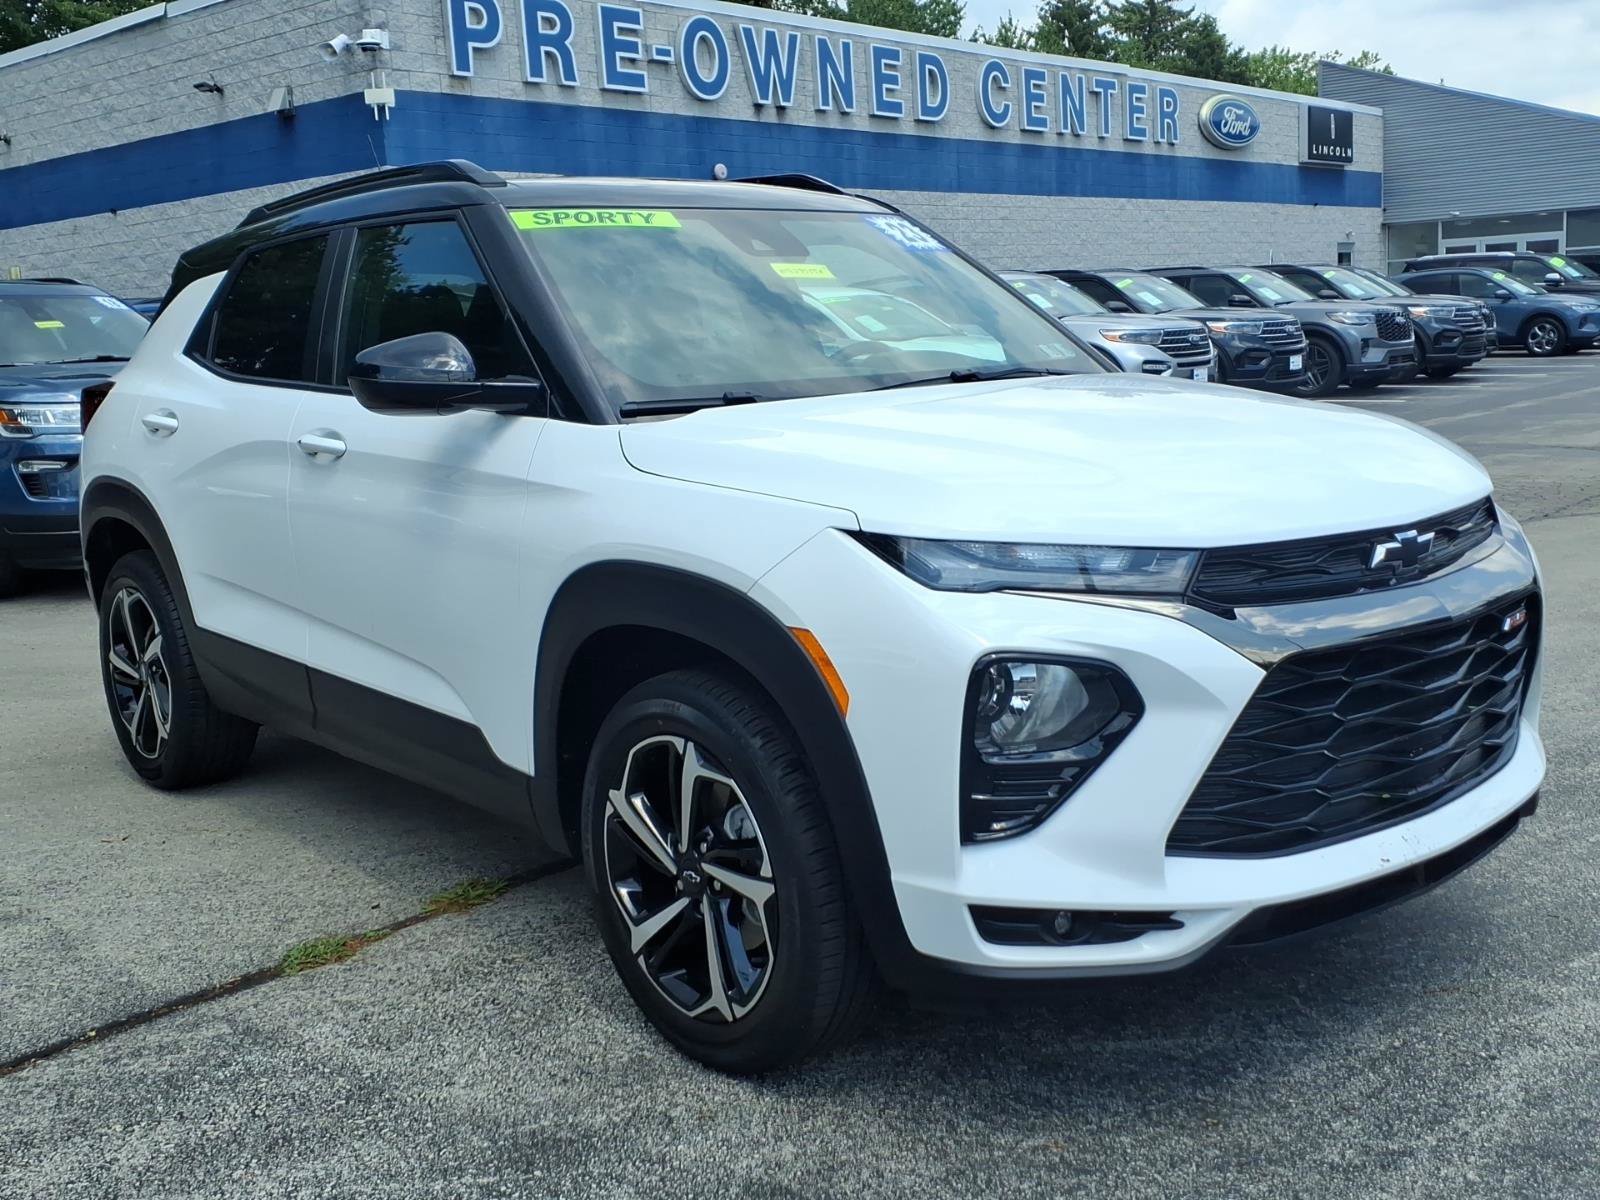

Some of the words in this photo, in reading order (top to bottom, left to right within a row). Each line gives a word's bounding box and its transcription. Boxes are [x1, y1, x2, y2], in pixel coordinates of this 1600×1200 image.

[448, 0, 949, 121] PRE-OWNED
[979, 58, 1180, 144] CENTER
[1220, 106, 1251, 136] Ford
[1312, 144, 1352, 157] LINCOLN
[532, 211, 656, 226] SPORTY
